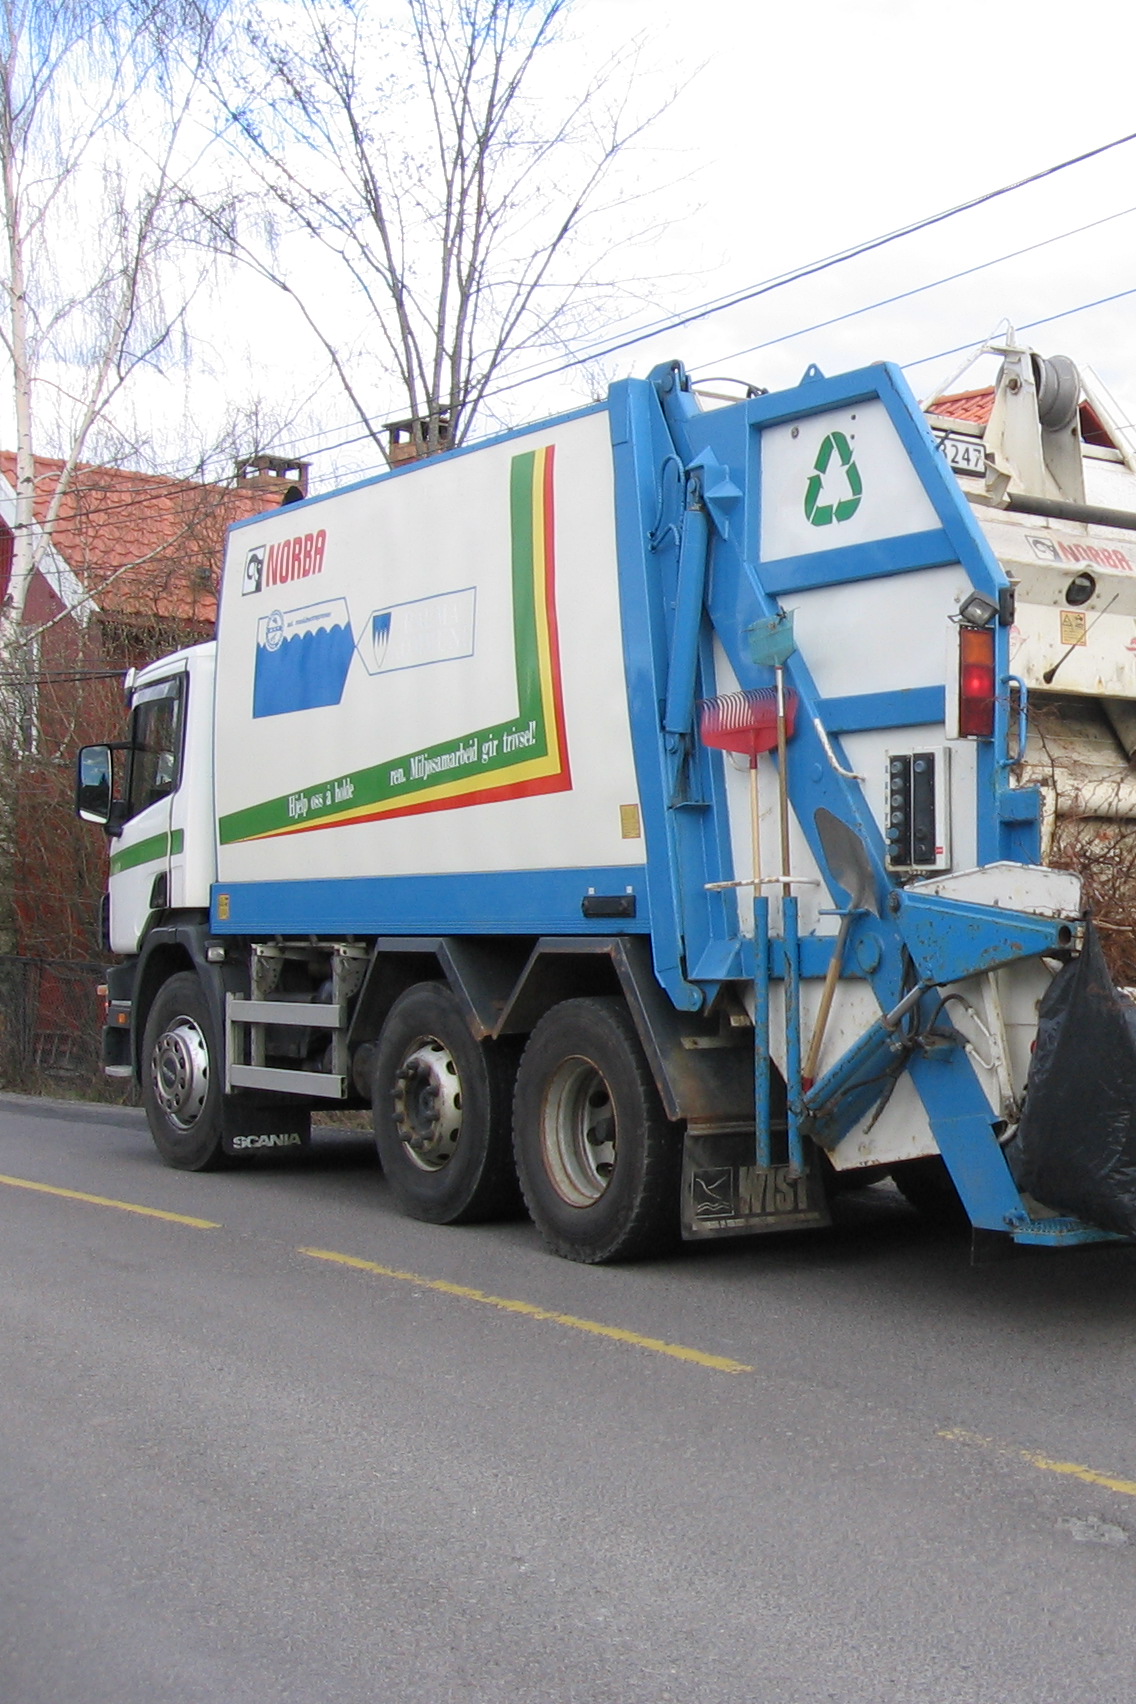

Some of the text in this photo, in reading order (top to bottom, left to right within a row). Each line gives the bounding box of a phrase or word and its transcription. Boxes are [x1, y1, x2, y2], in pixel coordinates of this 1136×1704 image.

[266, 529, 326, 587] NORBA
[1057, 541, 1133, 571] NORBA
[288, 792, 309, 819] Hjelp
[311, 793, 324, 810] oss
[325, 784, 332, 805] å
[334, 777, 355, 803] holde
[481, 733, 498, 764] gir
[503, 720, 537, 753] trivsel!
[232, 1132, 302, 1149] SCANIA
